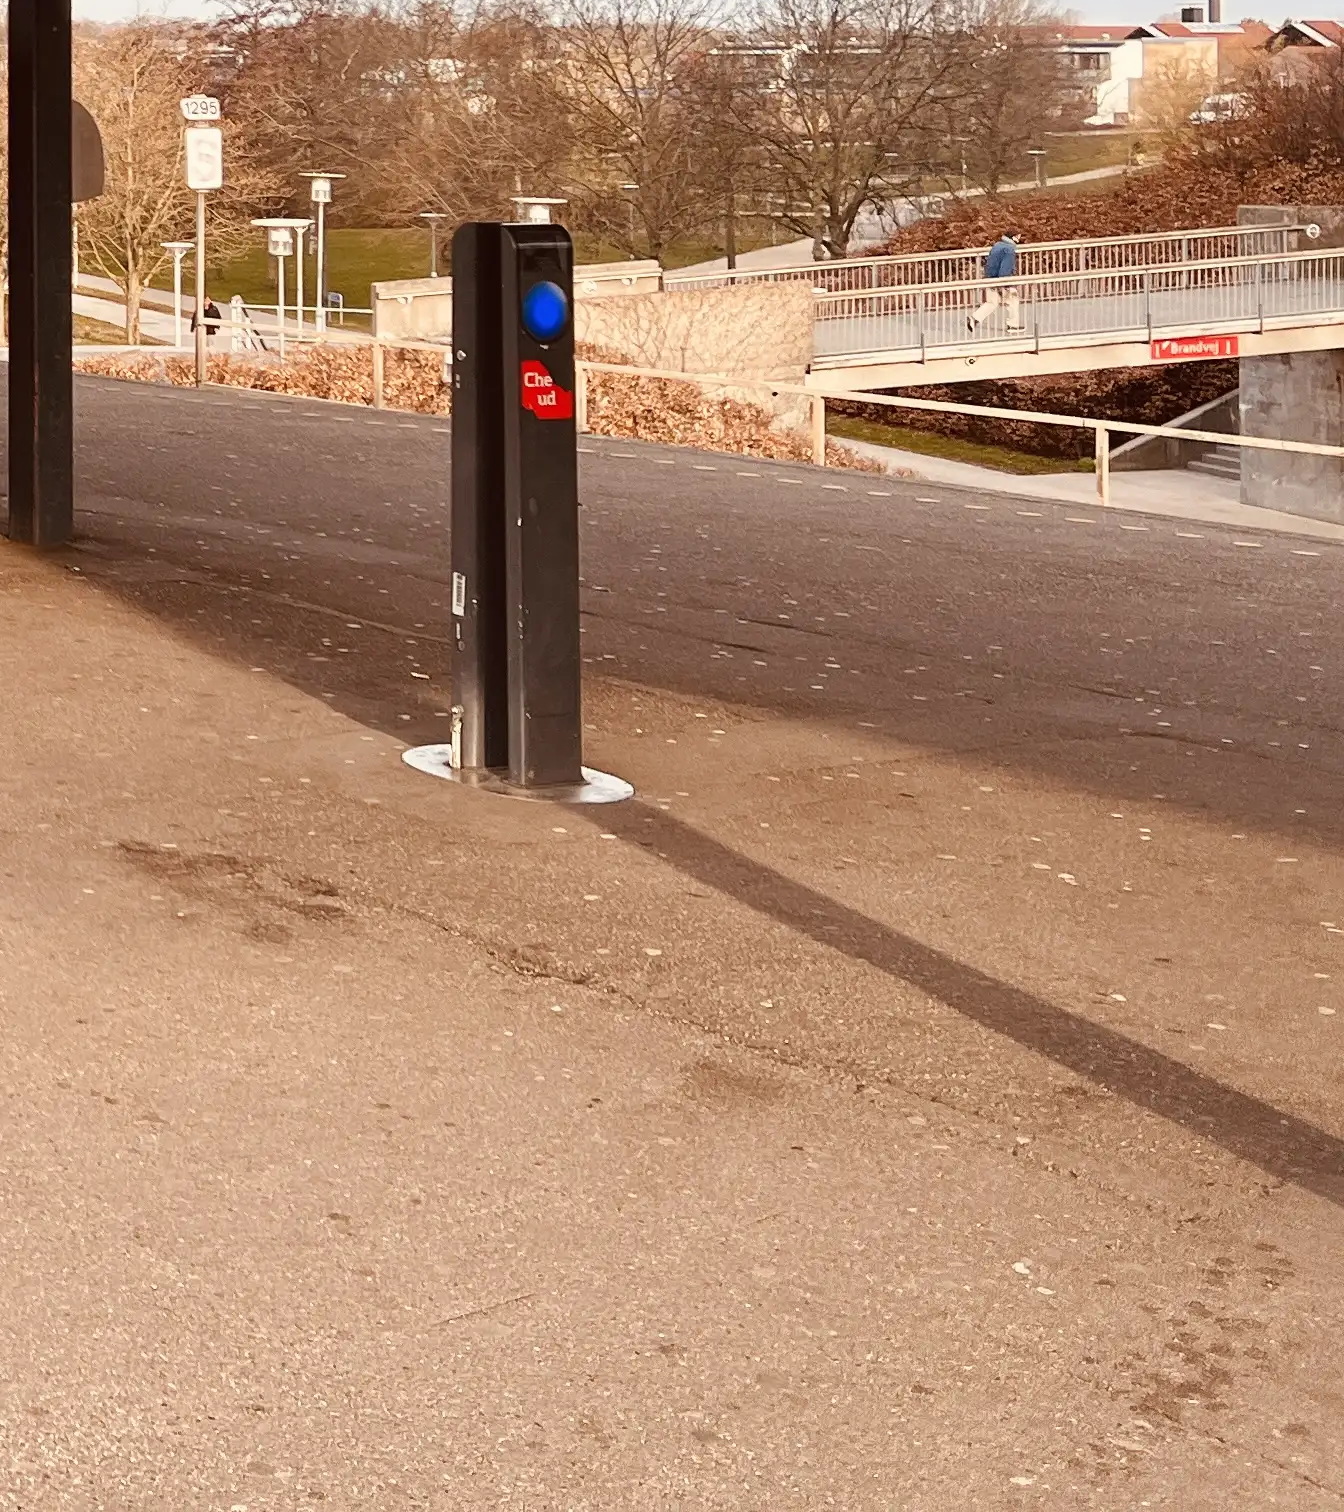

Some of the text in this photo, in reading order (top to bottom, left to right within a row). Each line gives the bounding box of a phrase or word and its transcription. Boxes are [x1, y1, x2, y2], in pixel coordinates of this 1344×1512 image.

[185, 101, 217, 115] 1295
[1170, 339, 1220, 356] Brandvej
[537, 390, 557, 406] ud
